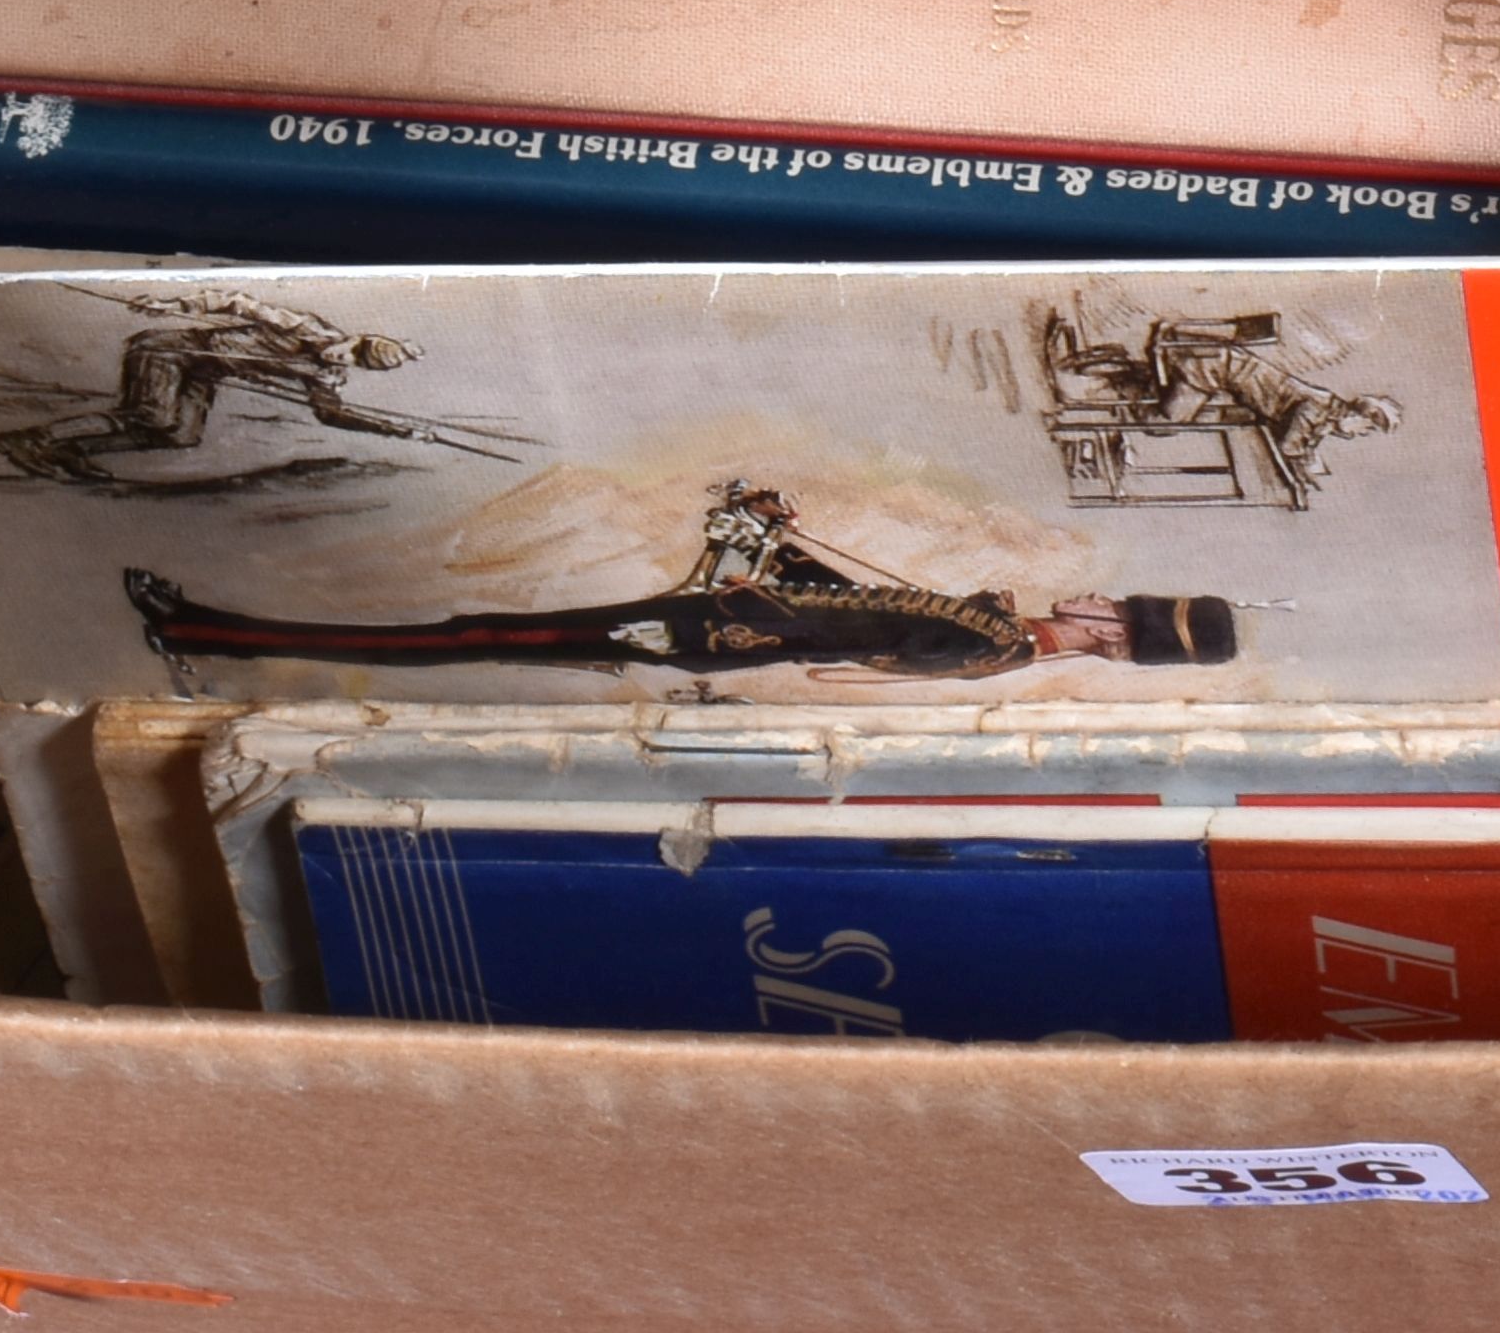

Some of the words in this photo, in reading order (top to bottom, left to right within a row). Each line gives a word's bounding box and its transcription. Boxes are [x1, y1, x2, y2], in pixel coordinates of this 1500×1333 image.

[270, 113, 375, 146] 1940
[558, 134, 698, 170] British
[710, 140, 780, 174] the
[786, 148, 832, 178] of
[842, 151, 1041, 194] Emblems
[1055, 164, 1092, 196] &
[1106, 167, 1258, 207] Badges
[1268, 179, 1314, 209] of
[1324, 183, 1436, 220] Book
[1163, 1159, 1427, 1195] 356
